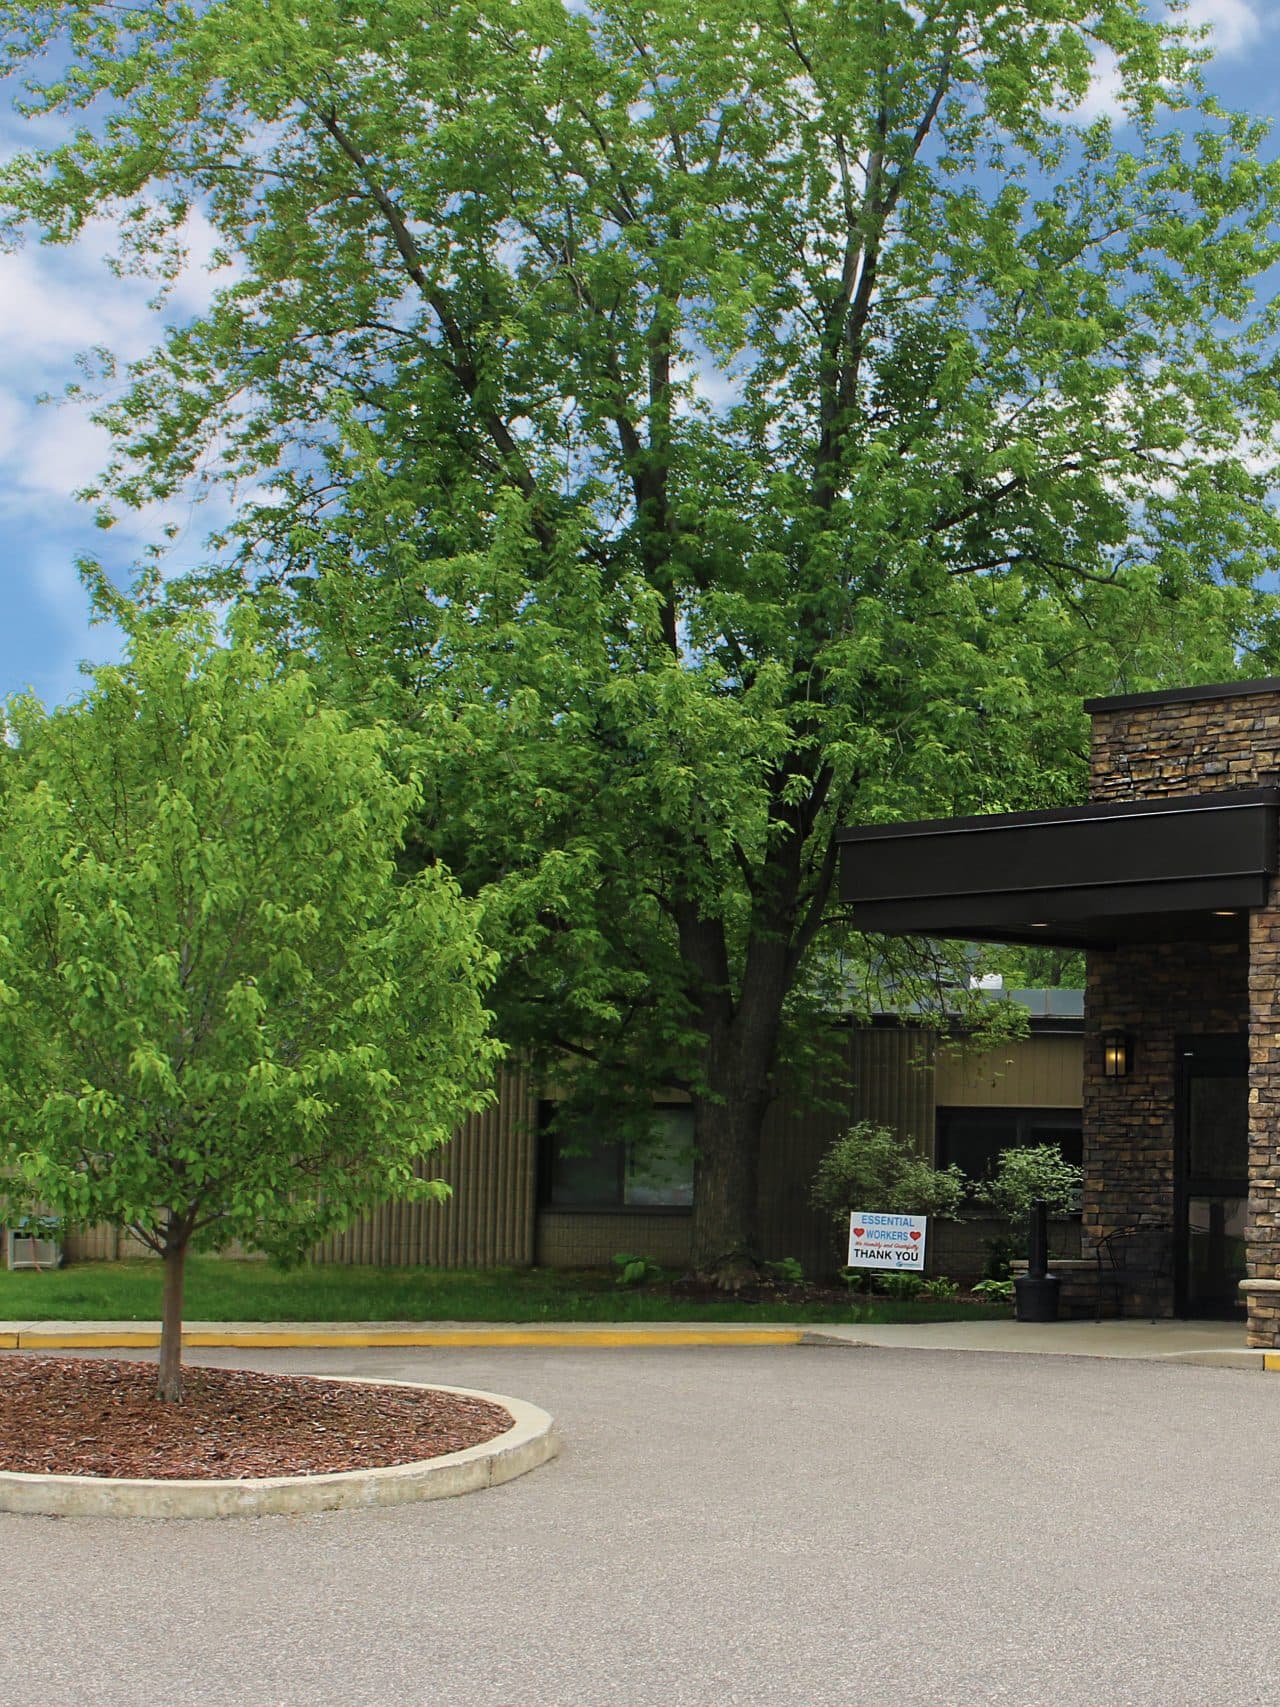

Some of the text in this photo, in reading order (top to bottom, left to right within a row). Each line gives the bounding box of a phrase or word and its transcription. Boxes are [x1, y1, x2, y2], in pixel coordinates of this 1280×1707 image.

[861, 1214, 915, 1227] ESSENTIAL
[866, 1229, 908, 1241] WORKERS
[853, 1248, 919, 1262] THANK YOU
